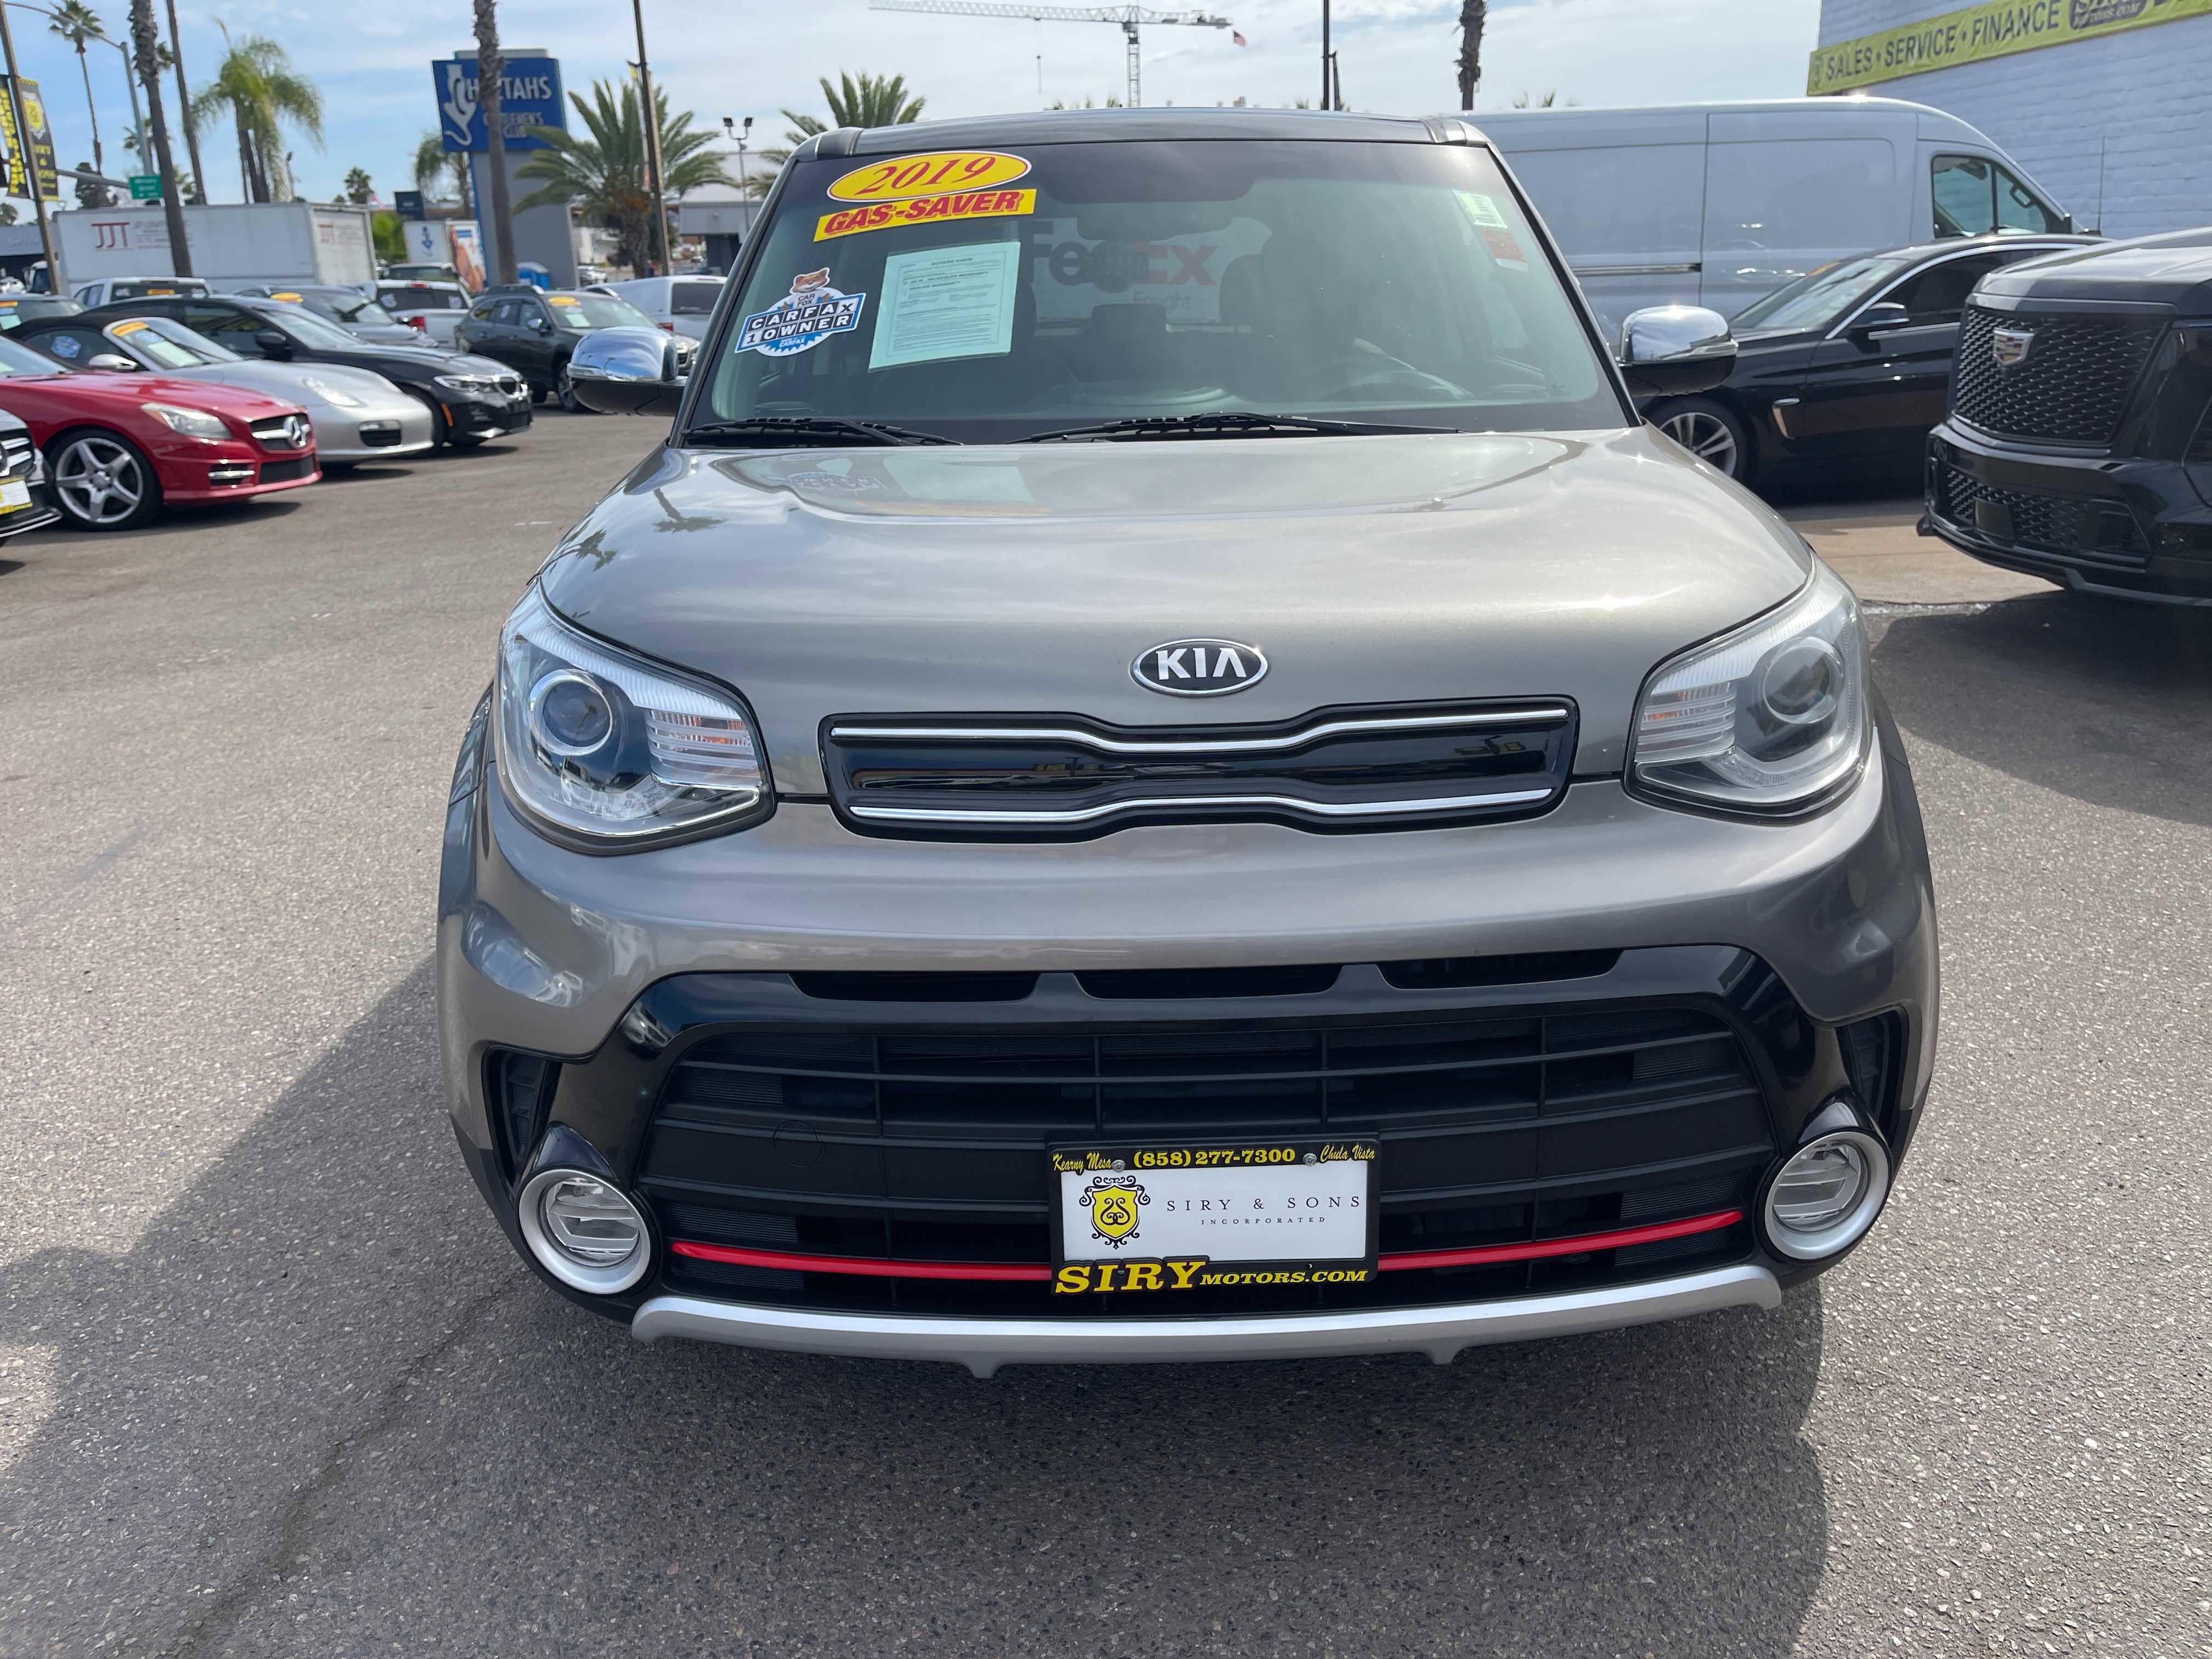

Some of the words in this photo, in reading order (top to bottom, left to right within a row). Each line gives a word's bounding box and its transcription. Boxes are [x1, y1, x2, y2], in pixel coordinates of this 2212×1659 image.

[1825, 47, 1873, 81] SALES
[1884, 25, 1957, 67] SERVICE
[1971, 0, 2060, 46] FINANCE
[454, 76, 552, 115] CHTAHS
[855, 156, 996, 196] 2019
[823, 190, 1024, 236] GAS-SAVER
[746, 333, 756, 344] 1
[763, 314, 850, 340] OWNER
[751, 302, 854, 329] CARFAX
[1156, 647, 1247, 680] KIA
[1053, 1152, 1084, 1175] Kearny
[1086, 1152, 1112, 1170] Mesa
[1133, 1149, 1191, 1168] (858)
[1195, 1148, 1295, 1166] 277-7300
[1320, 1144, 1348, 1162] Chula
[1352, 1143, 1376, 1160] Vista
[1167, 1199, 1232, 1211] SIRY
[1253, 1198, 1265, 1209] &
[1287, 1196, 1359, 1208] SONS
[1201, 1216, 1325, 1225] INCORPORATED
